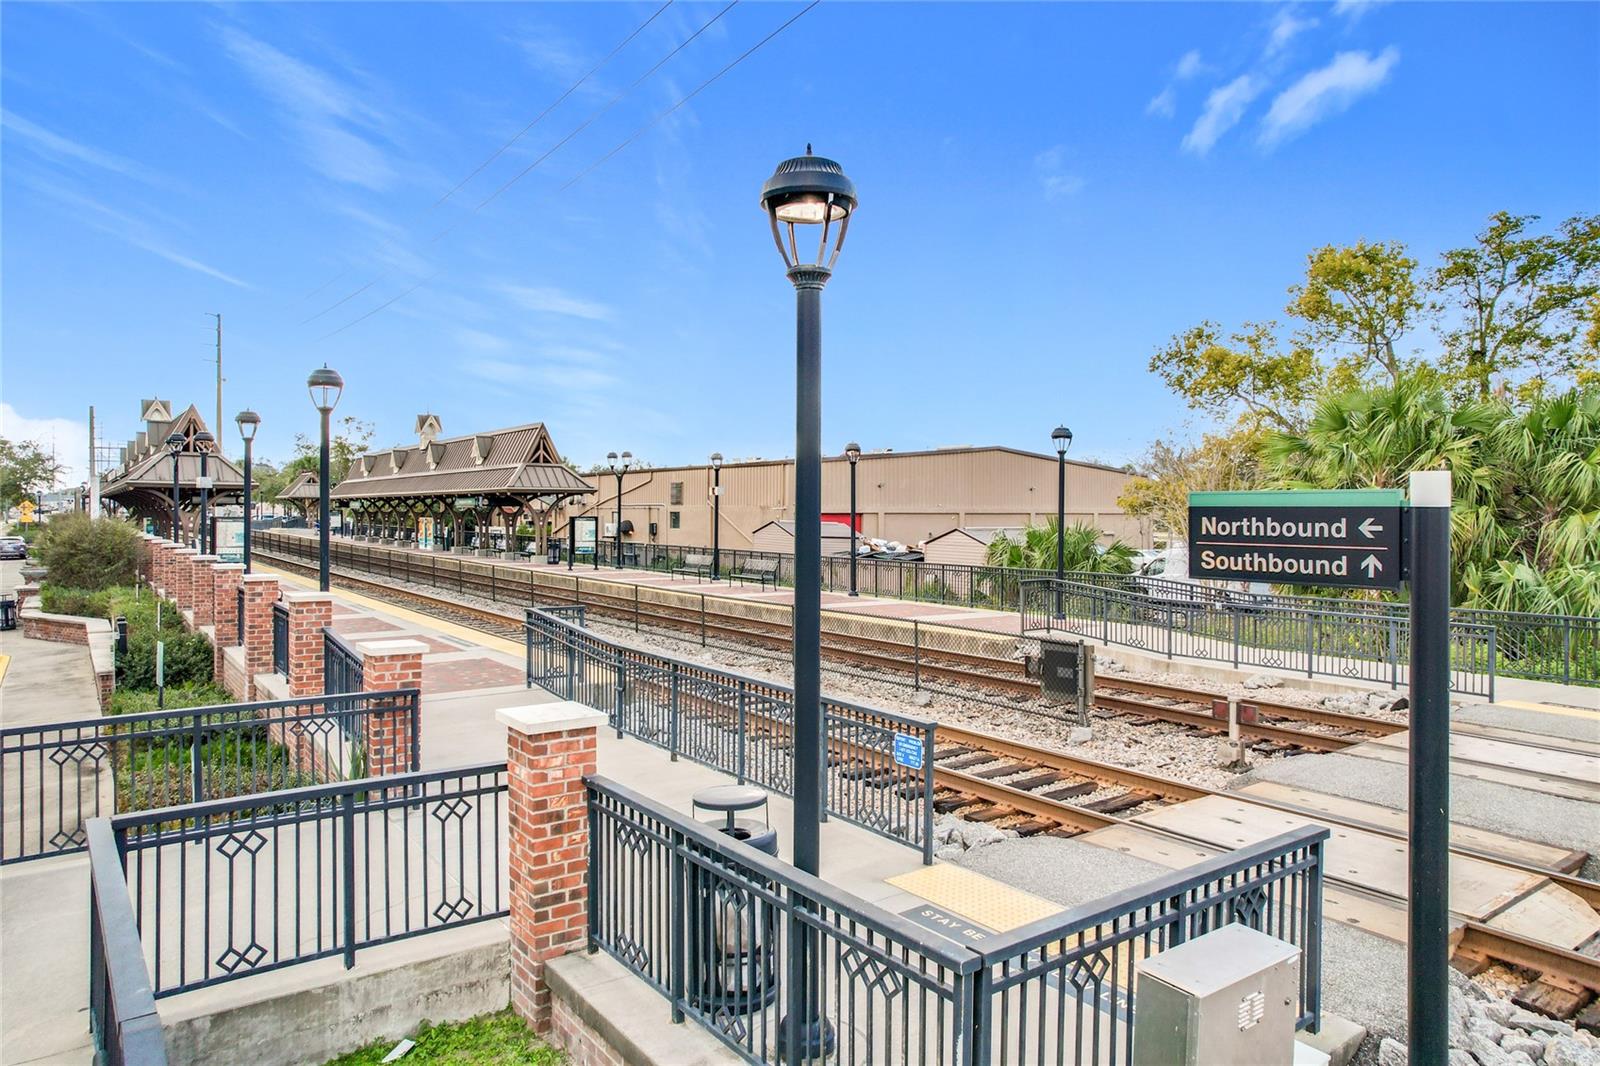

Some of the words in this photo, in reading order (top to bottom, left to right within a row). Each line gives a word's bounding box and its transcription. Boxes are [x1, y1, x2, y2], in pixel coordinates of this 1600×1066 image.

[1201, 516, 1347, 538] Northbound
[1201, 550, 1347, 576] Southbound
[921, 910, 961, 929] STAY
